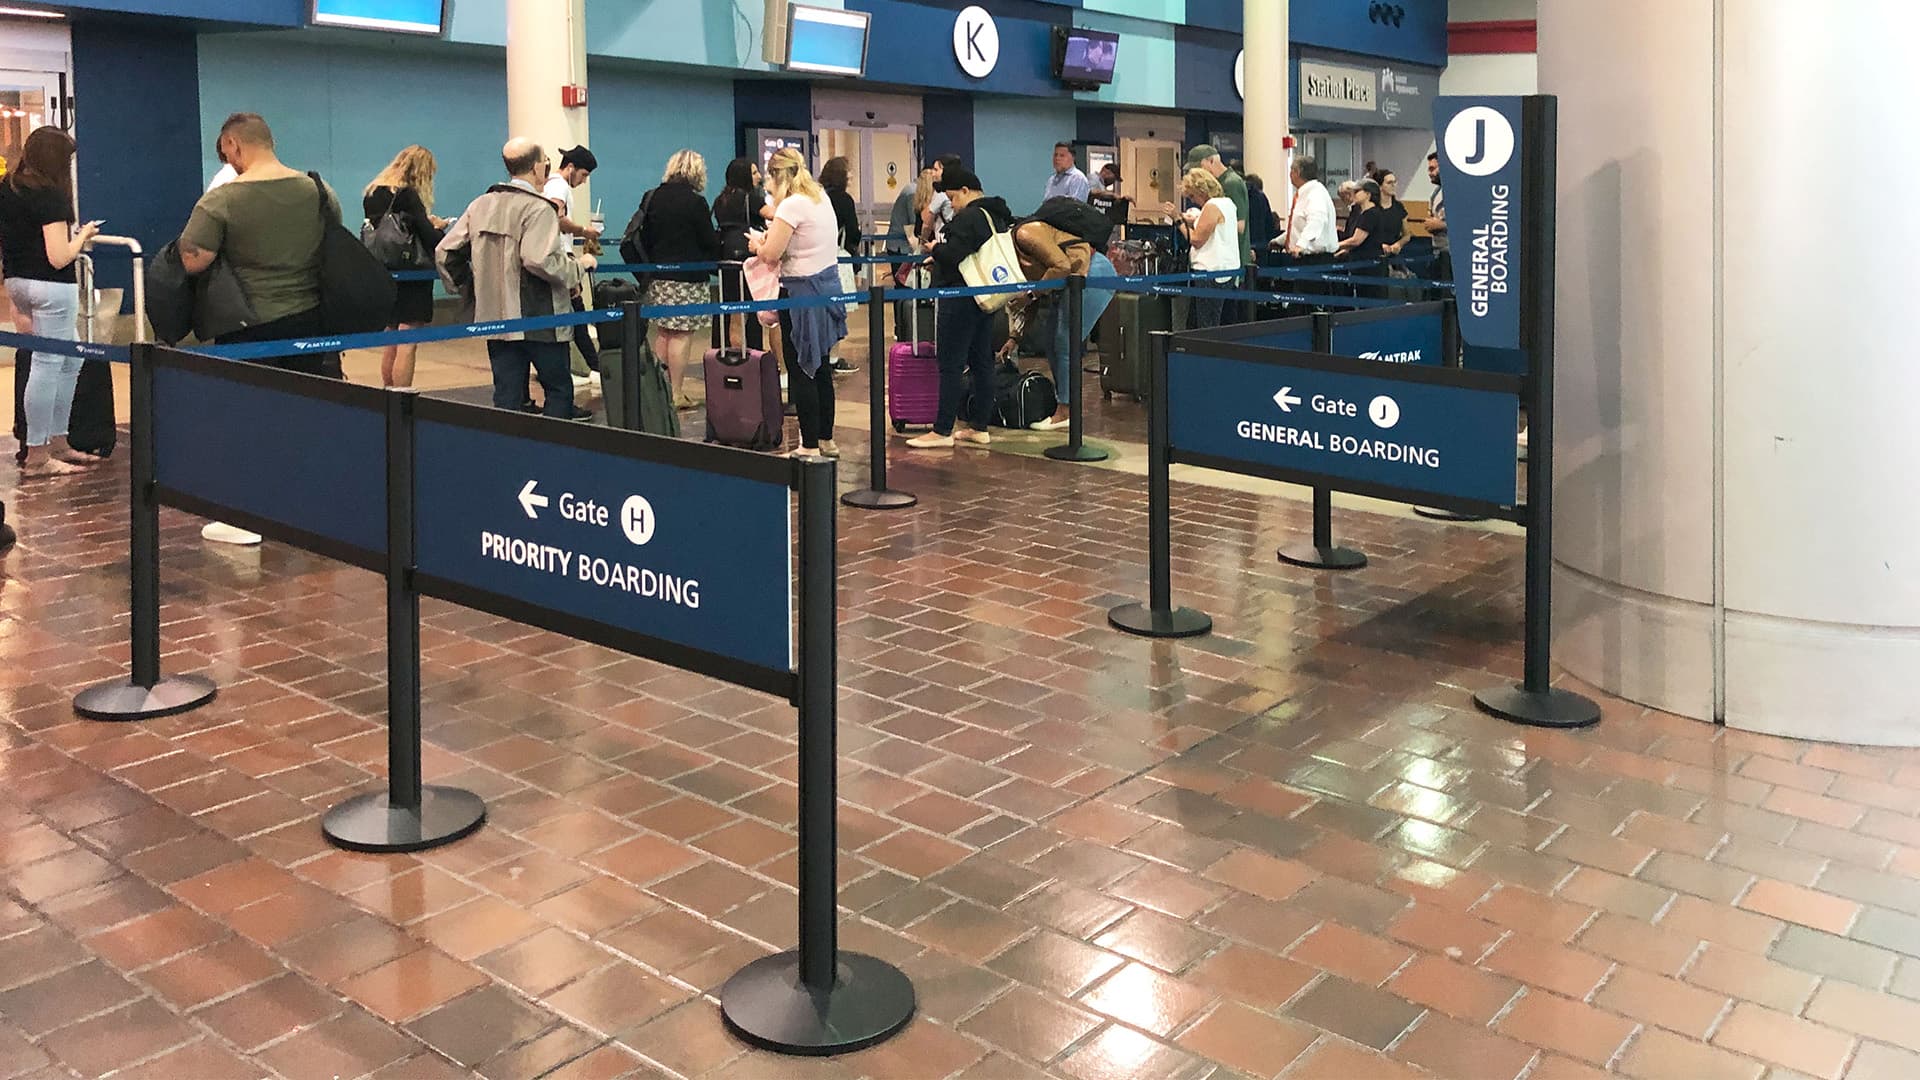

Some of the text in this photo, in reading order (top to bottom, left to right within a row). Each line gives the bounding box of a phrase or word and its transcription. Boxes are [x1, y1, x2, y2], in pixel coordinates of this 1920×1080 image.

[967, 20, 986, 62] K
[1308, 72, 1344, 98] Station
[1345, 77, 1371, 102] Place
[1465, 119, 1486, 164] J
[1491, 184, 1509, 294] BOARDING
[1471, 223, 1489, 317] GENERAL
[307, 340, 341, 348] AMTRAK
[1311, 394, 1387, 420] Gate J
[1237, 421, 1440, 468] GENERAL BOARDING
[559, 492, 645, 534] Gate H
[481, 531, 699, 609] PRIORITY BOARDING
